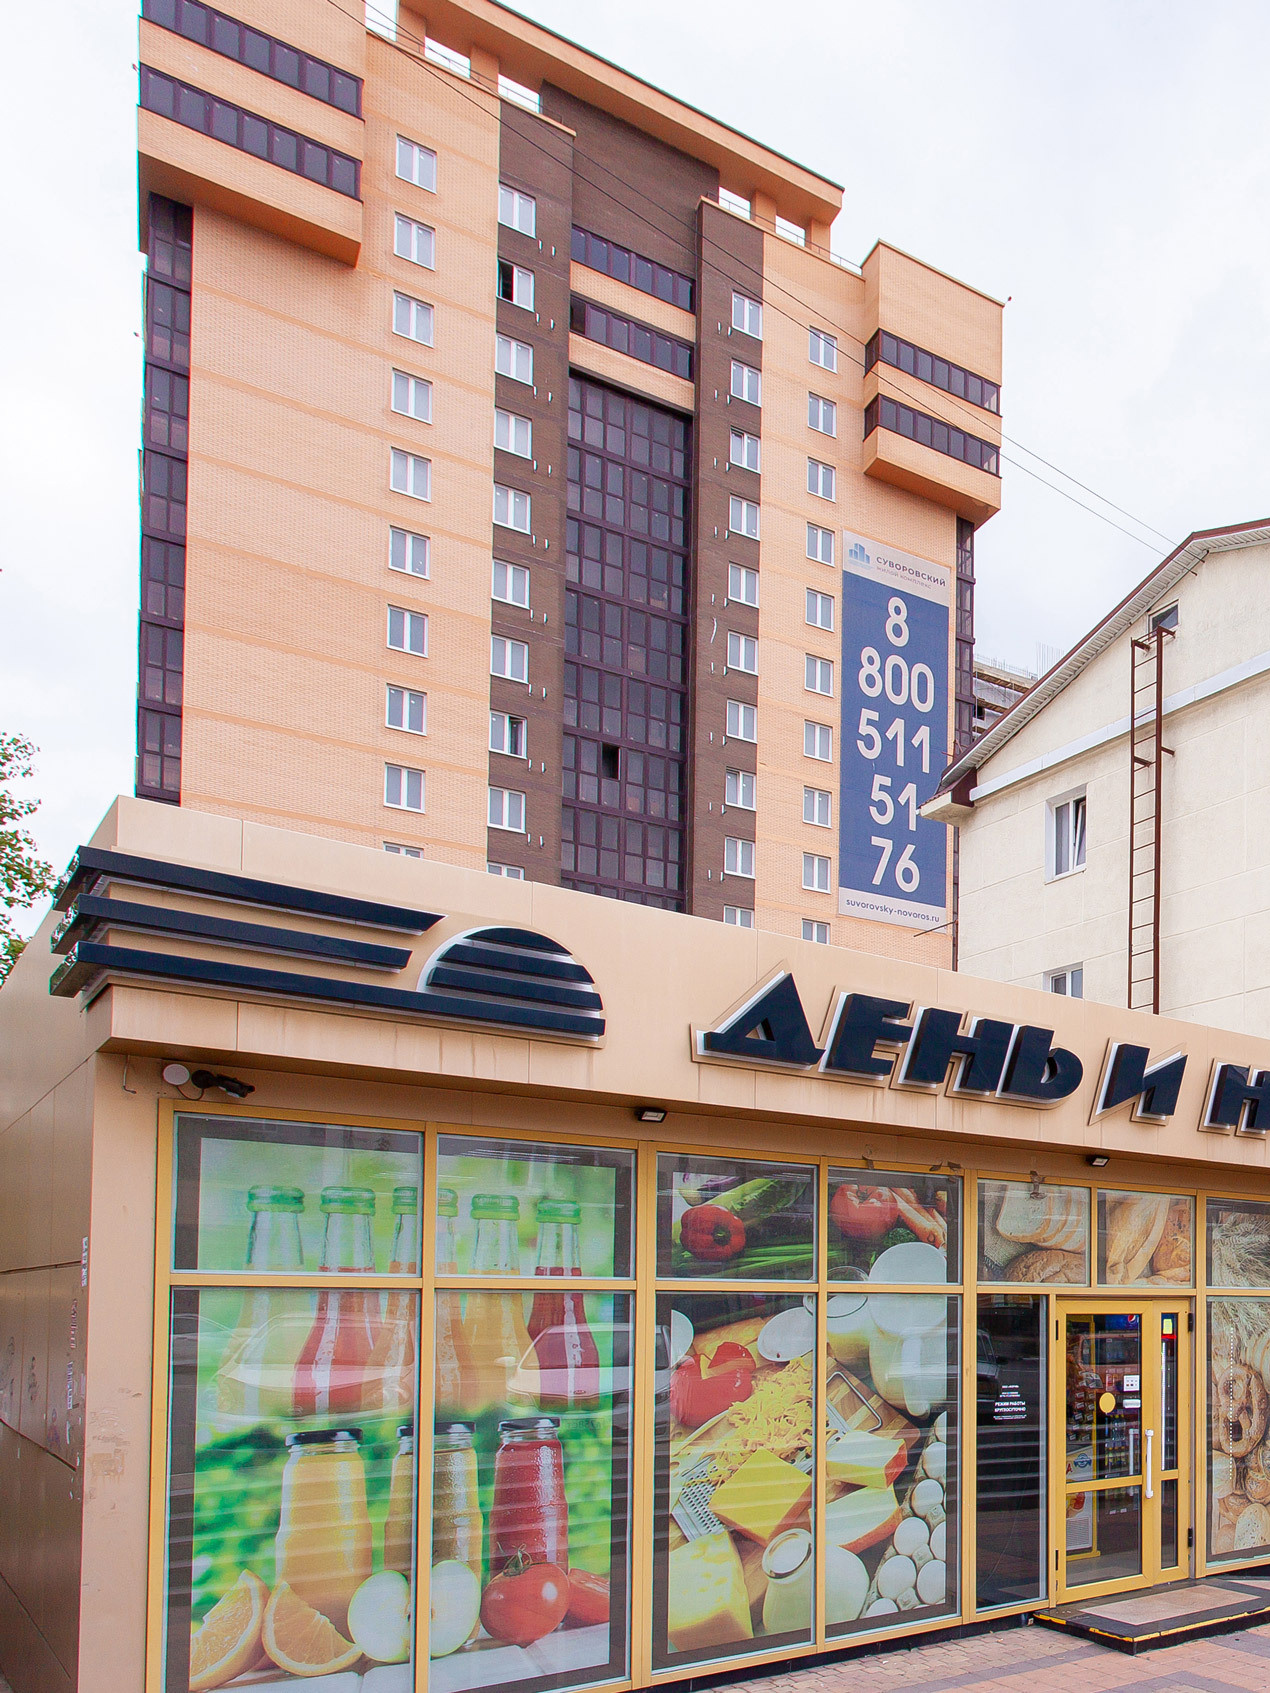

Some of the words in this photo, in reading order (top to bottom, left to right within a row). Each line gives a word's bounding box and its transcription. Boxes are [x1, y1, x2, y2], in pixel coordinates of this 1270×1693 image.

[876, 556, 946, 587] СУВОРОВСКИЙ
[885, 596, 910, 648] 8
[858, 646, 935, 713] 800
[856, 707, 930, 774] 511
[868, 773, 917, 832] 51
[870, 835, 920, 893] 76
[846, 899, 940, 923] suvorovsky-novoros.ru
[697, 971, 1086, 1105] ДЕНЬ
[1096, 1043, 1188, 1119] И
